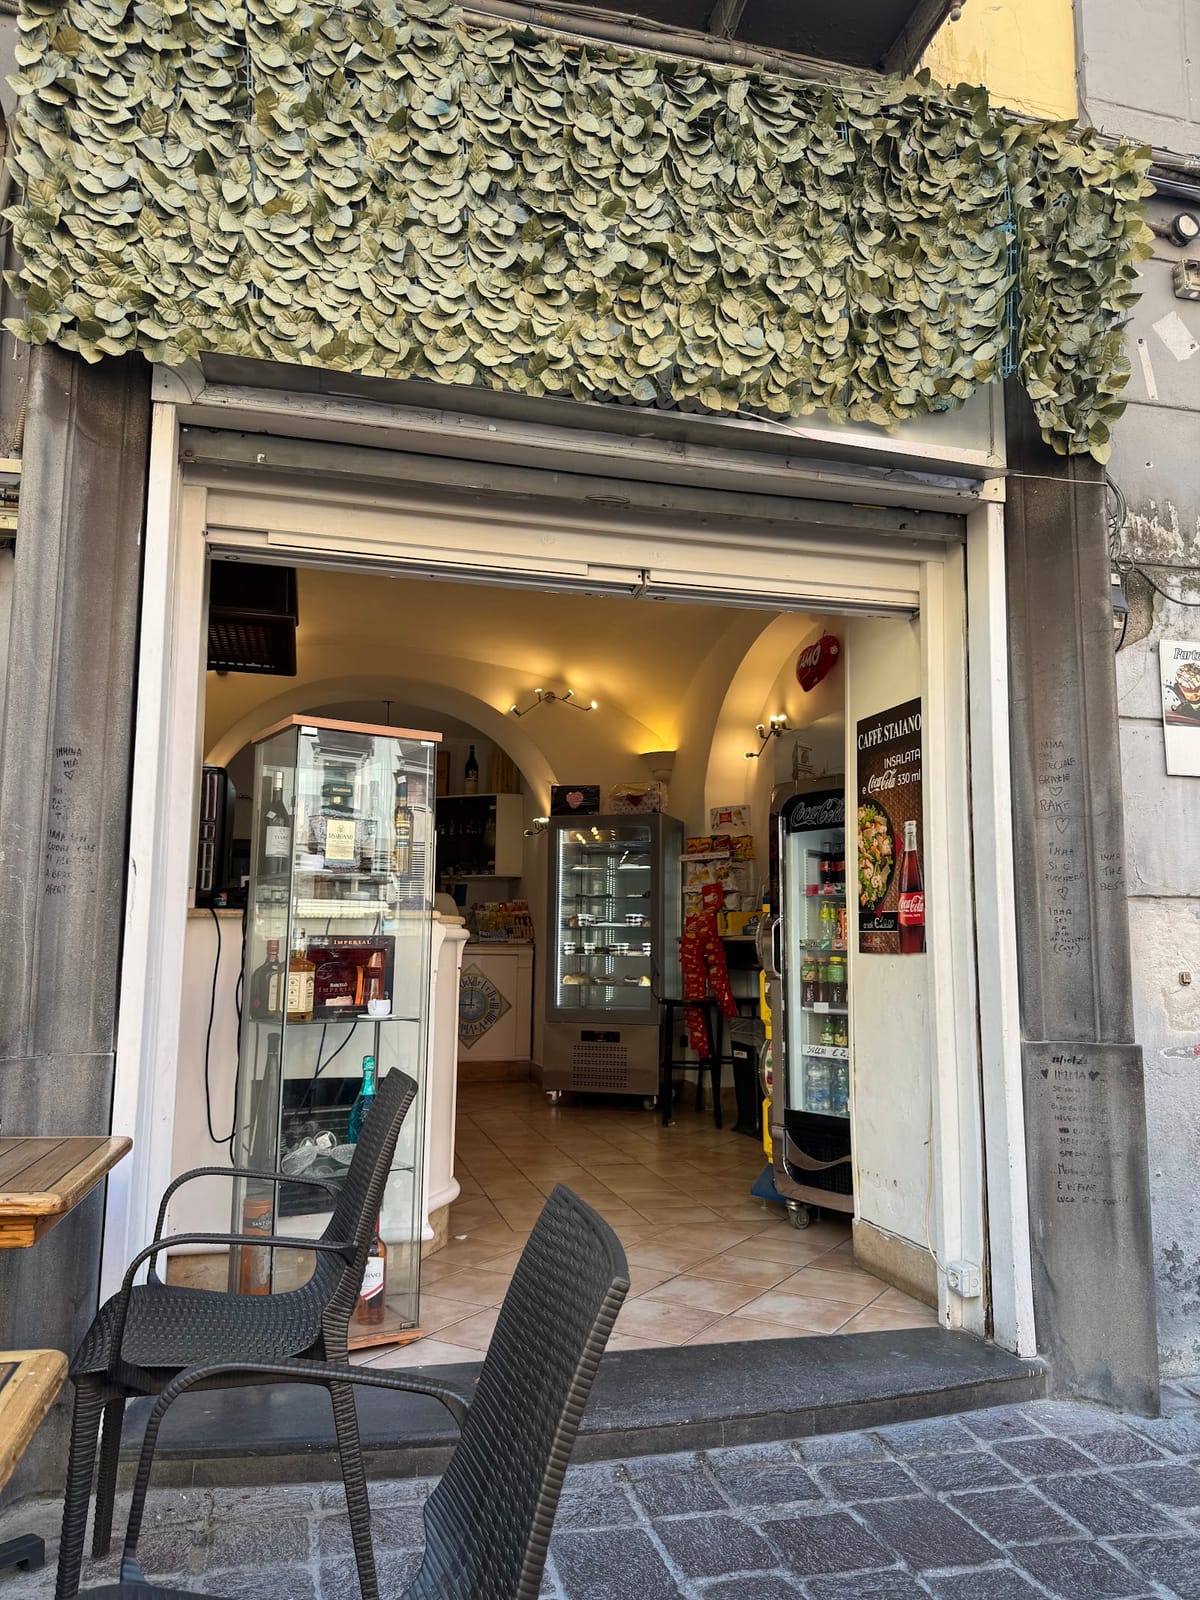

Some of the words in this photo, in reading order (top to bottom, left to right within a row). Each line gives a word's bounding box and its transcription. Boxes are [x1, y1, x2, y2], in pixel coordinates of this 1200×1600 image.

[858, 723, 882, 750] CAFFÈ
[883, 713, 921, 742] STAIANO
[884, 748, 921, 769] INSALATA
[862, 786, 867, 795] e
[897, 772, 910, 786] 330
[911, 769, 921, 782] ml
